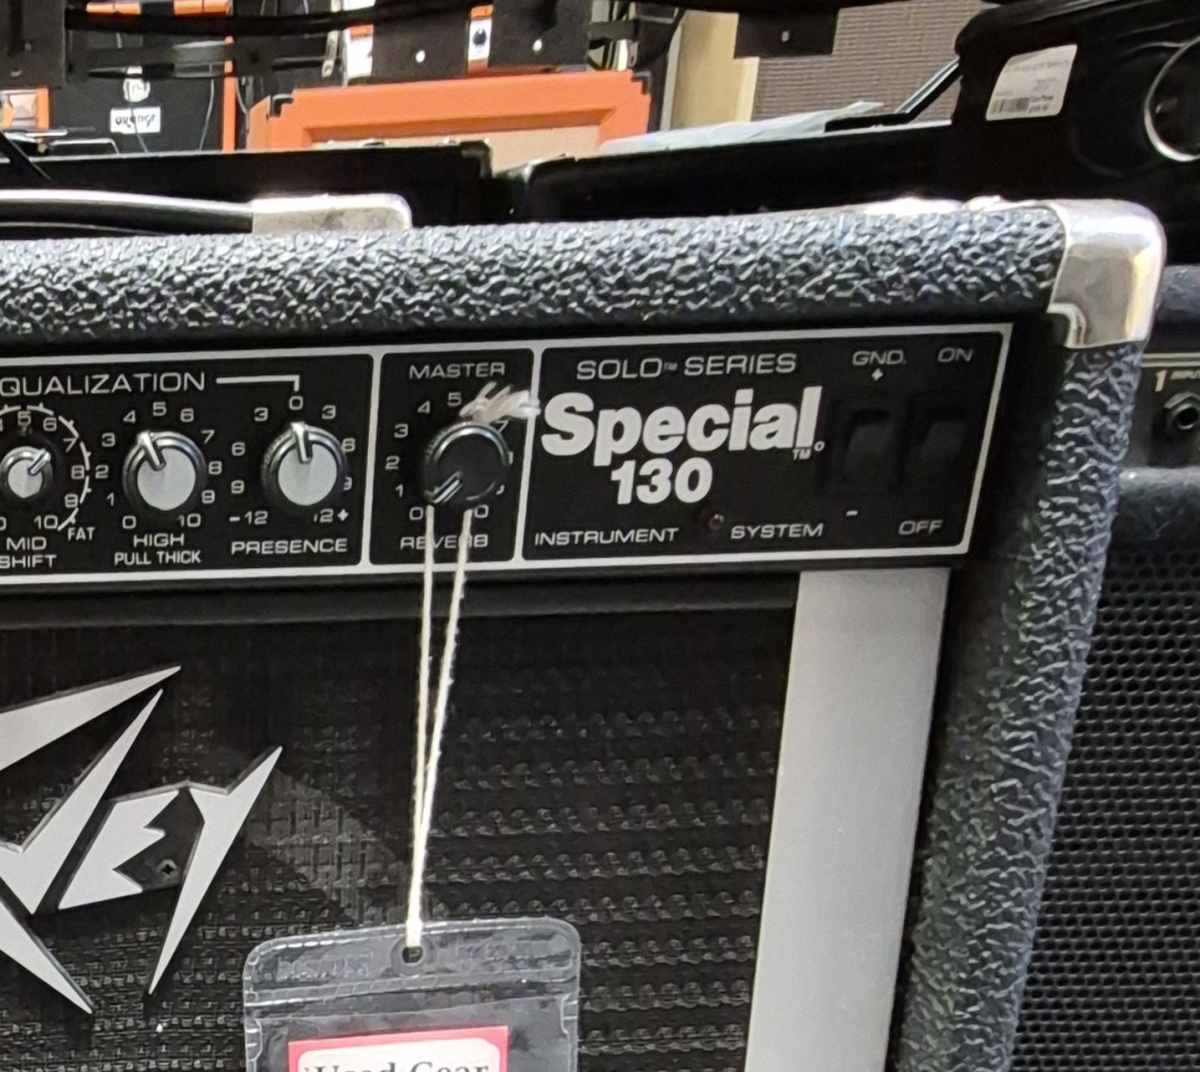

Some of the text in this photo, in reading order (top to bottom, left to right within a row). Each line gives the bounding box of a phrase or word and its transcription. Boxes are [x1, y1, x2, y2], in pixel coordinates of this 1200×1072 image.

[937, 347, 974, 363] ON
[409, 362, 506, 380] MASTER
[577, 358, 663, 380] SOLO
[683, 353, 797, 377] SERIES
[289, 396, 304, 410] 0
[417, 400, 431, 414] 4
[447, 392, 462, 407] 5
[123, 410, 136, 423] 4
[152, 402, 167, 416] 5
[180, 408, 194, 422] 6
[254, 408, 269, 422] 3
[322, 405, 336, 419] 3
[17, 411, 31, 426] 5
[43, 417, 57, 431] 6
[541, 385, 823, 467] Special
[201, 430, 215, 444] 7
[394, 423, 409, 438] 3
[63, 437, 77, 452] 7
[101, 432, 116, 447] 3
[341, 437, 356, 452] 6
[231, 442, 245, 456] 6
[208, 461, 223, 475] 8
[385, 455, 400, 470] 2
[71, 465, 85, 479] 8
[95, 464, 109, 479] 2
[231, 480, 245, 494] 9
[610, 456, 714, 505] 130
[201, 489, 216, 504] 9
[395, 484, 404, 498] 1
[64, 493, 78, 508] 9
[106, 493, 115, 506] 1
[177, 513, 201, 527] 10
[409, 506, 424, 521] 0
[34, 515, 58, 530] 10
[122, 515, 137, 530] 0
[898, 519, 943, 535] OFF
[67, 527, 96, 541] FAT
[534, 528, 679, 546] INSTRUMENT
[730, 523, 824, 540] SYSTEM
[6, 536, 47, 550] MID
[133, 533, 185, 547] HIGH
[231, 538, 348, 555] PRESENCE
[114, 550, 202, 566] PULL THICK
